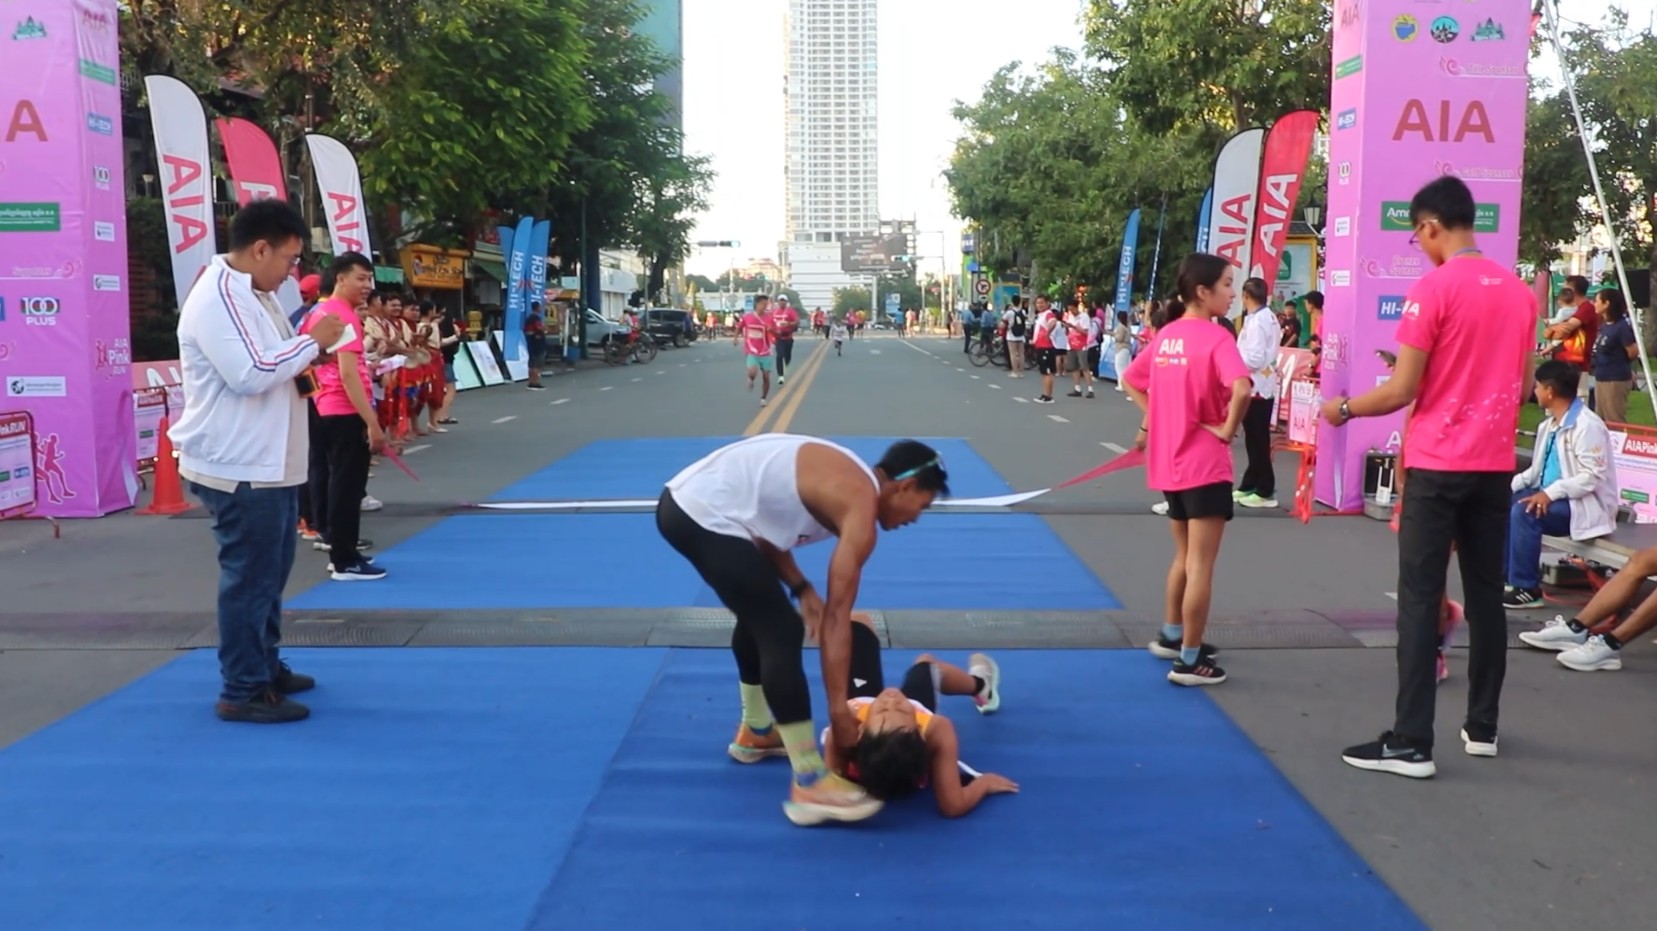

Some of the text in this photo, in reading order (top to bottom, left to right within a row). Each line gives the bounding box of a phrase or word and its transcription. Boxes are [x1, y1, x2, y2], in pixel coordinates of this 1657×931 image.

[1392, 98, 1495, 143] AIA
[163, 154, 208, 254] AIA
[1216, 193, 1252, 269] AIA
[1259, 173, 1298, 258] AIA
[509, 251, 525, 309] HI-TECH
[1117, 245, 1132, 304] HI-TECH
[22, 297, 59, 315] 100
[26, 316, 56, 326] PLUS
[1158, 338, 1185, 355] AIA
